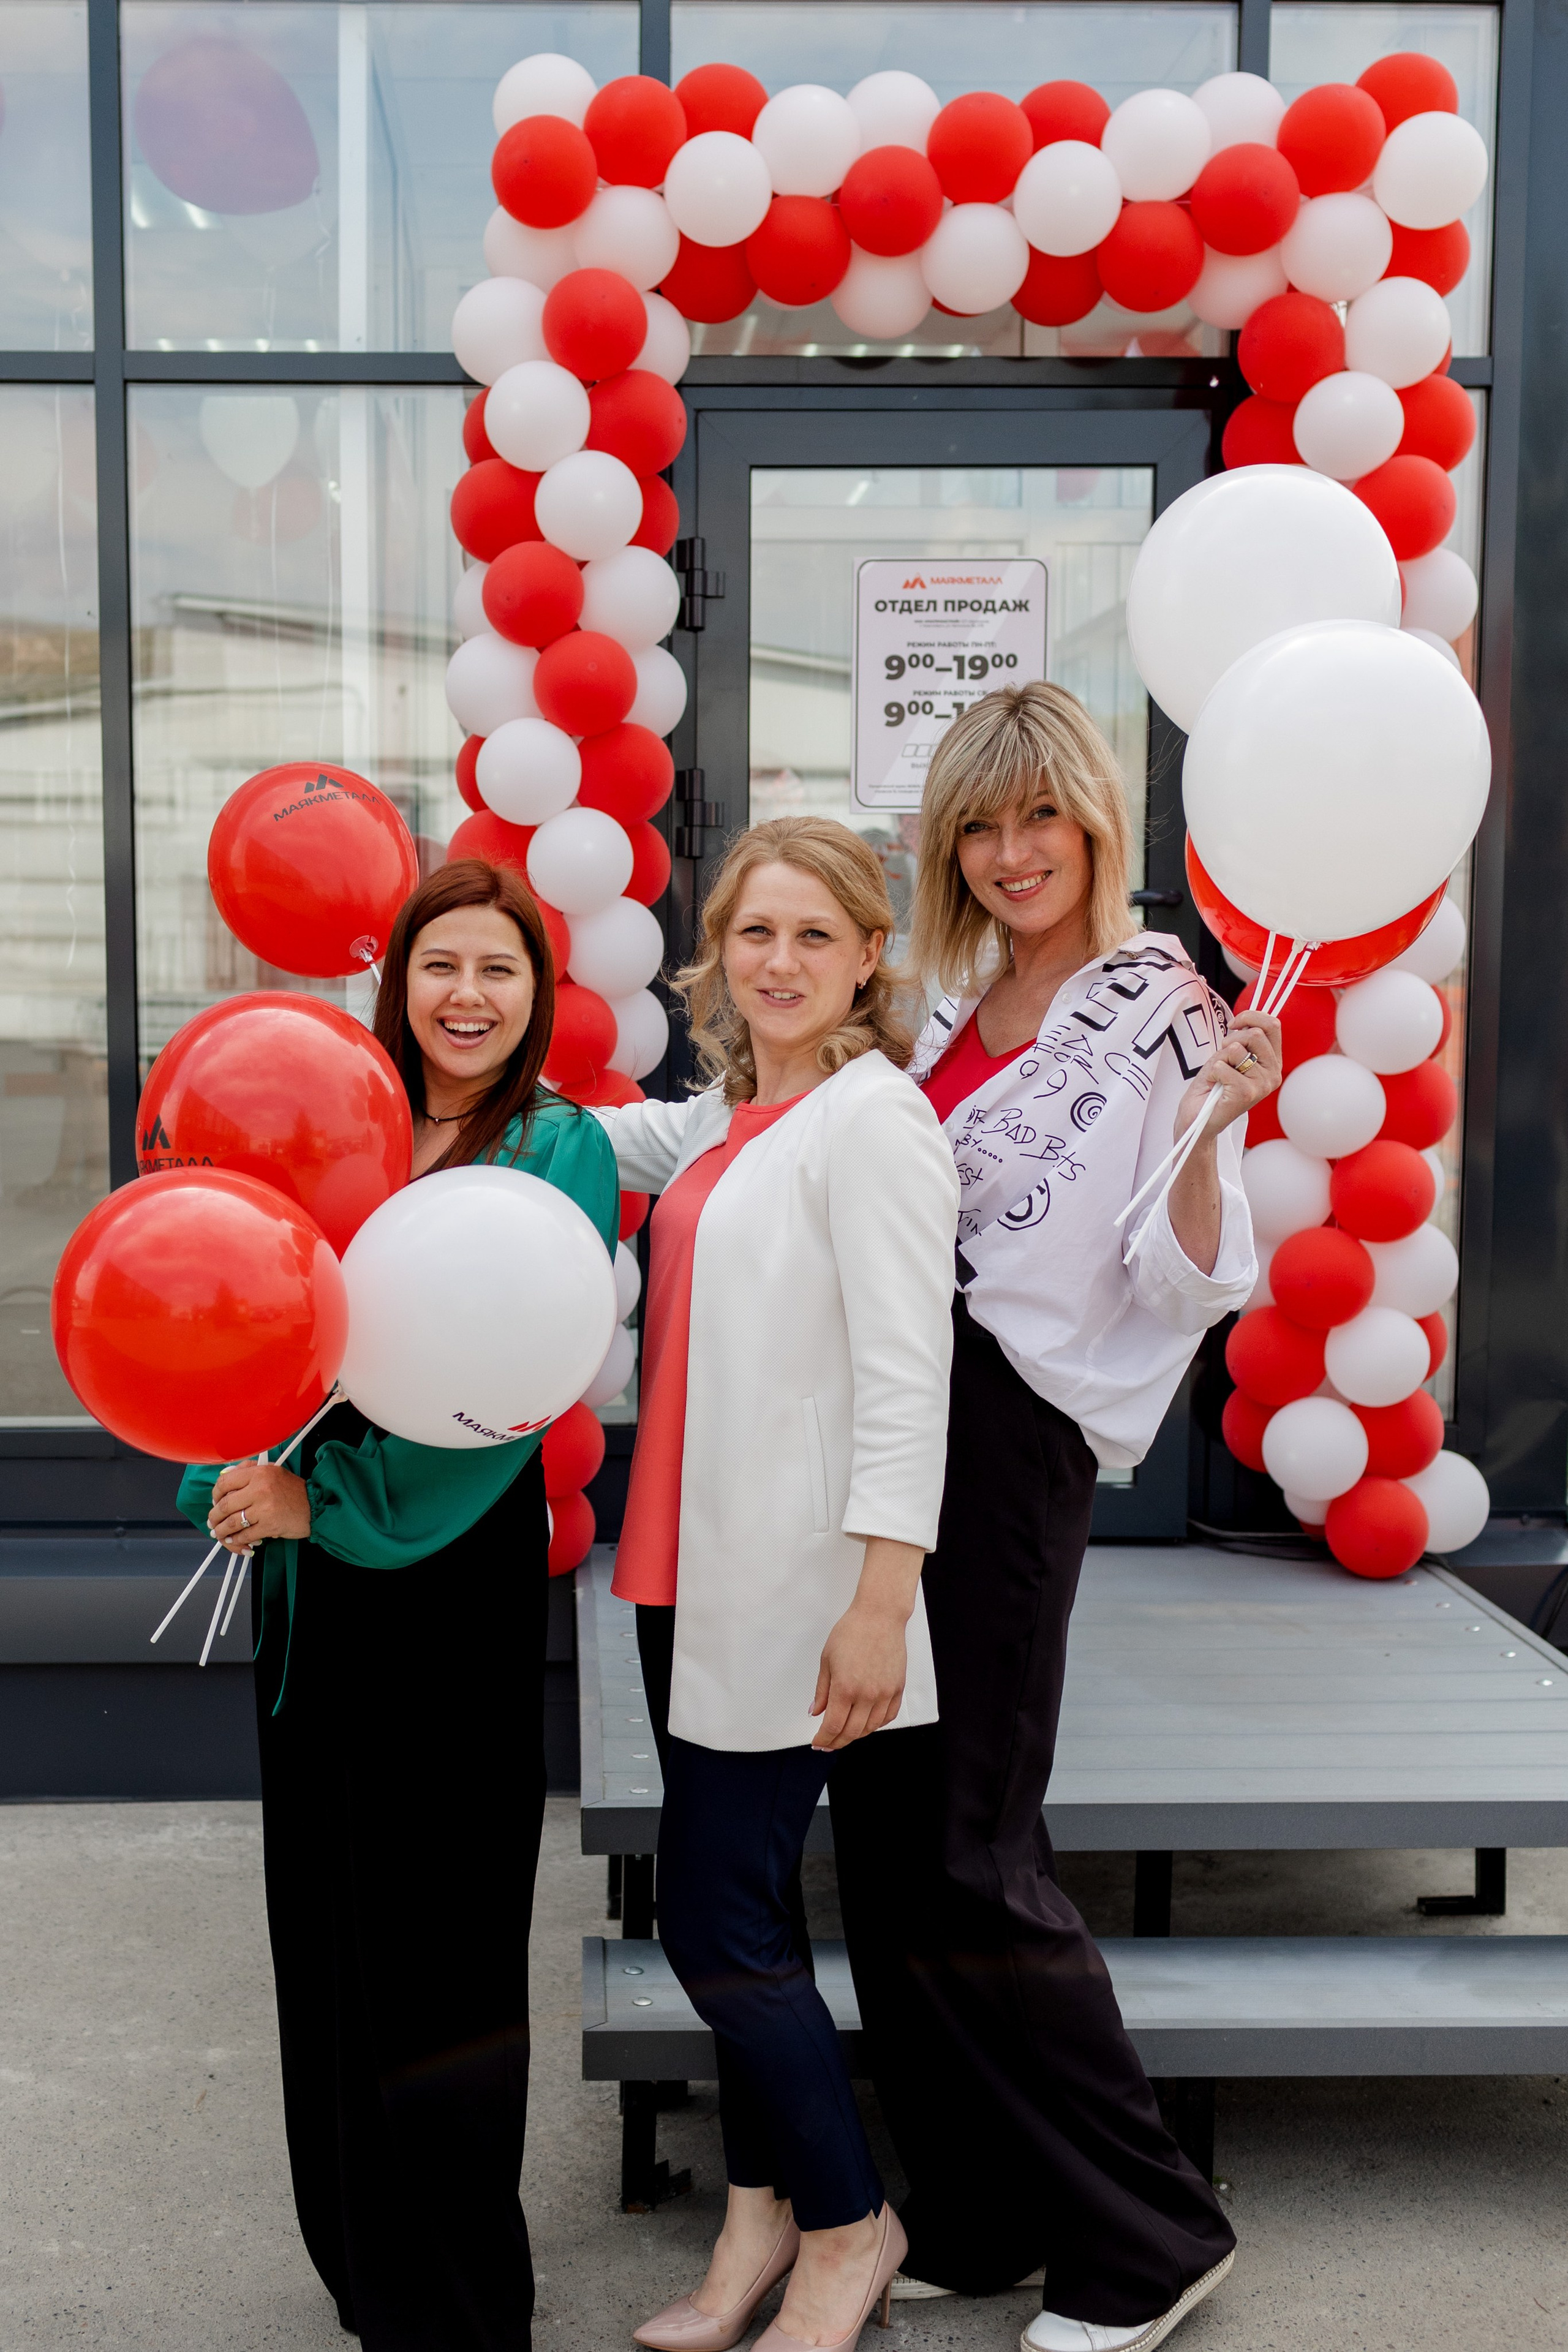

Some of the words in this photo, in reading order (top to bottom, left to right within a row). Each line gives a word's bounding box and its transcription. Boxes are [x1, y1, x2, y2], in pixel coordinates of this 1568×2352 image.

[875, 600, 937, 614] ОТДЕЛ
[944, 600, 1030, 614] ПРОДАЖ
[273, 791, 381, 821] МАЯКМЕТАЛЛ
